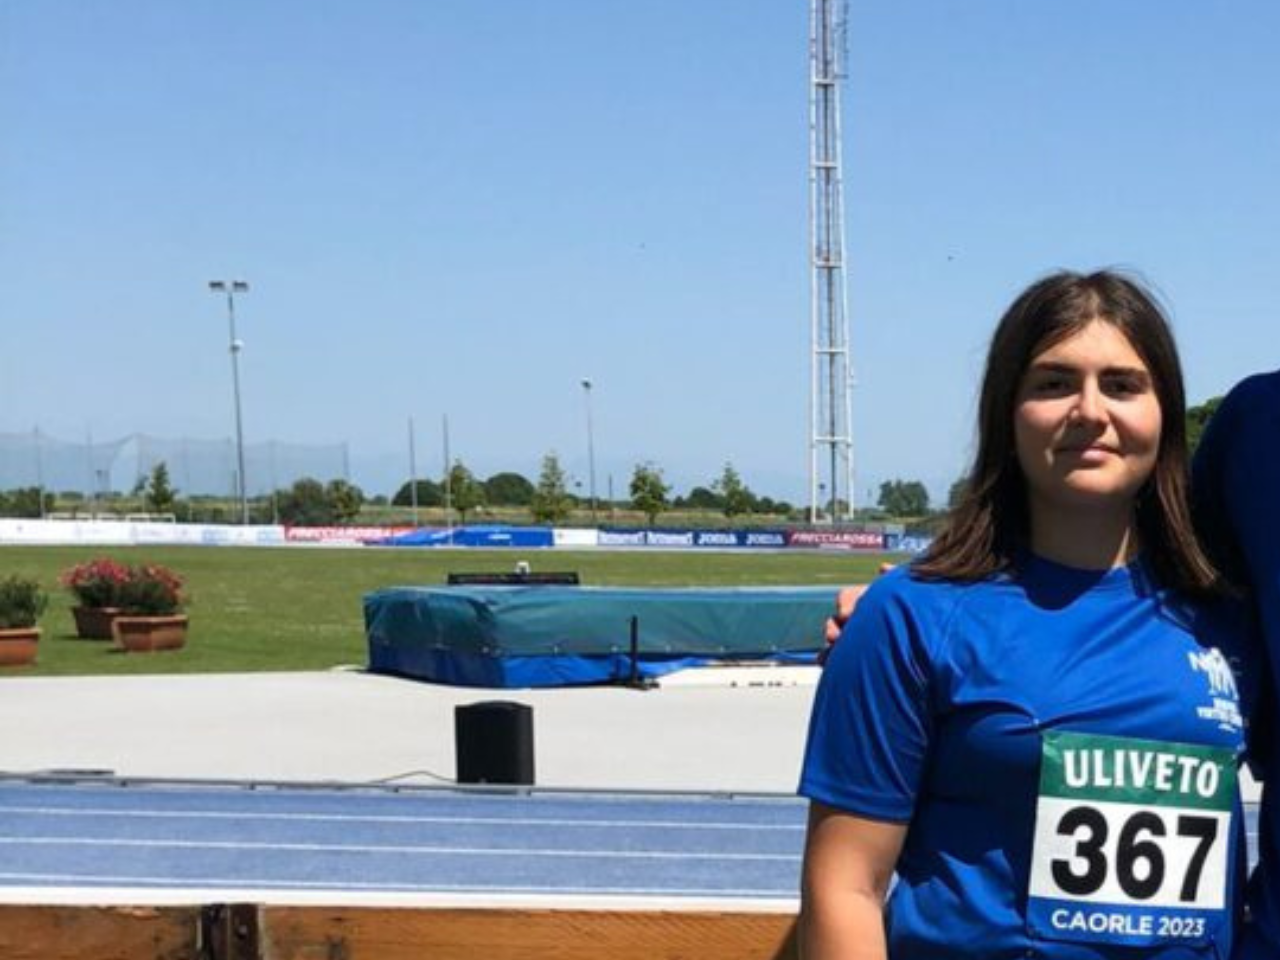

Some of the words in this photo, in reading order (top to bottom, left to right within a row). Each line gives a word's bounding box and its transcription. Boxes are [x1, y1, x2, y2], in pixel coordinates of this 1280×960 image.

[1064, 750, 1219, 797] ULIVETO
[1051, 806, 1218, 902] 367
[1052, 909, 1153, 935] CAORLE
[1157, 918, 1206, 938] 2023
